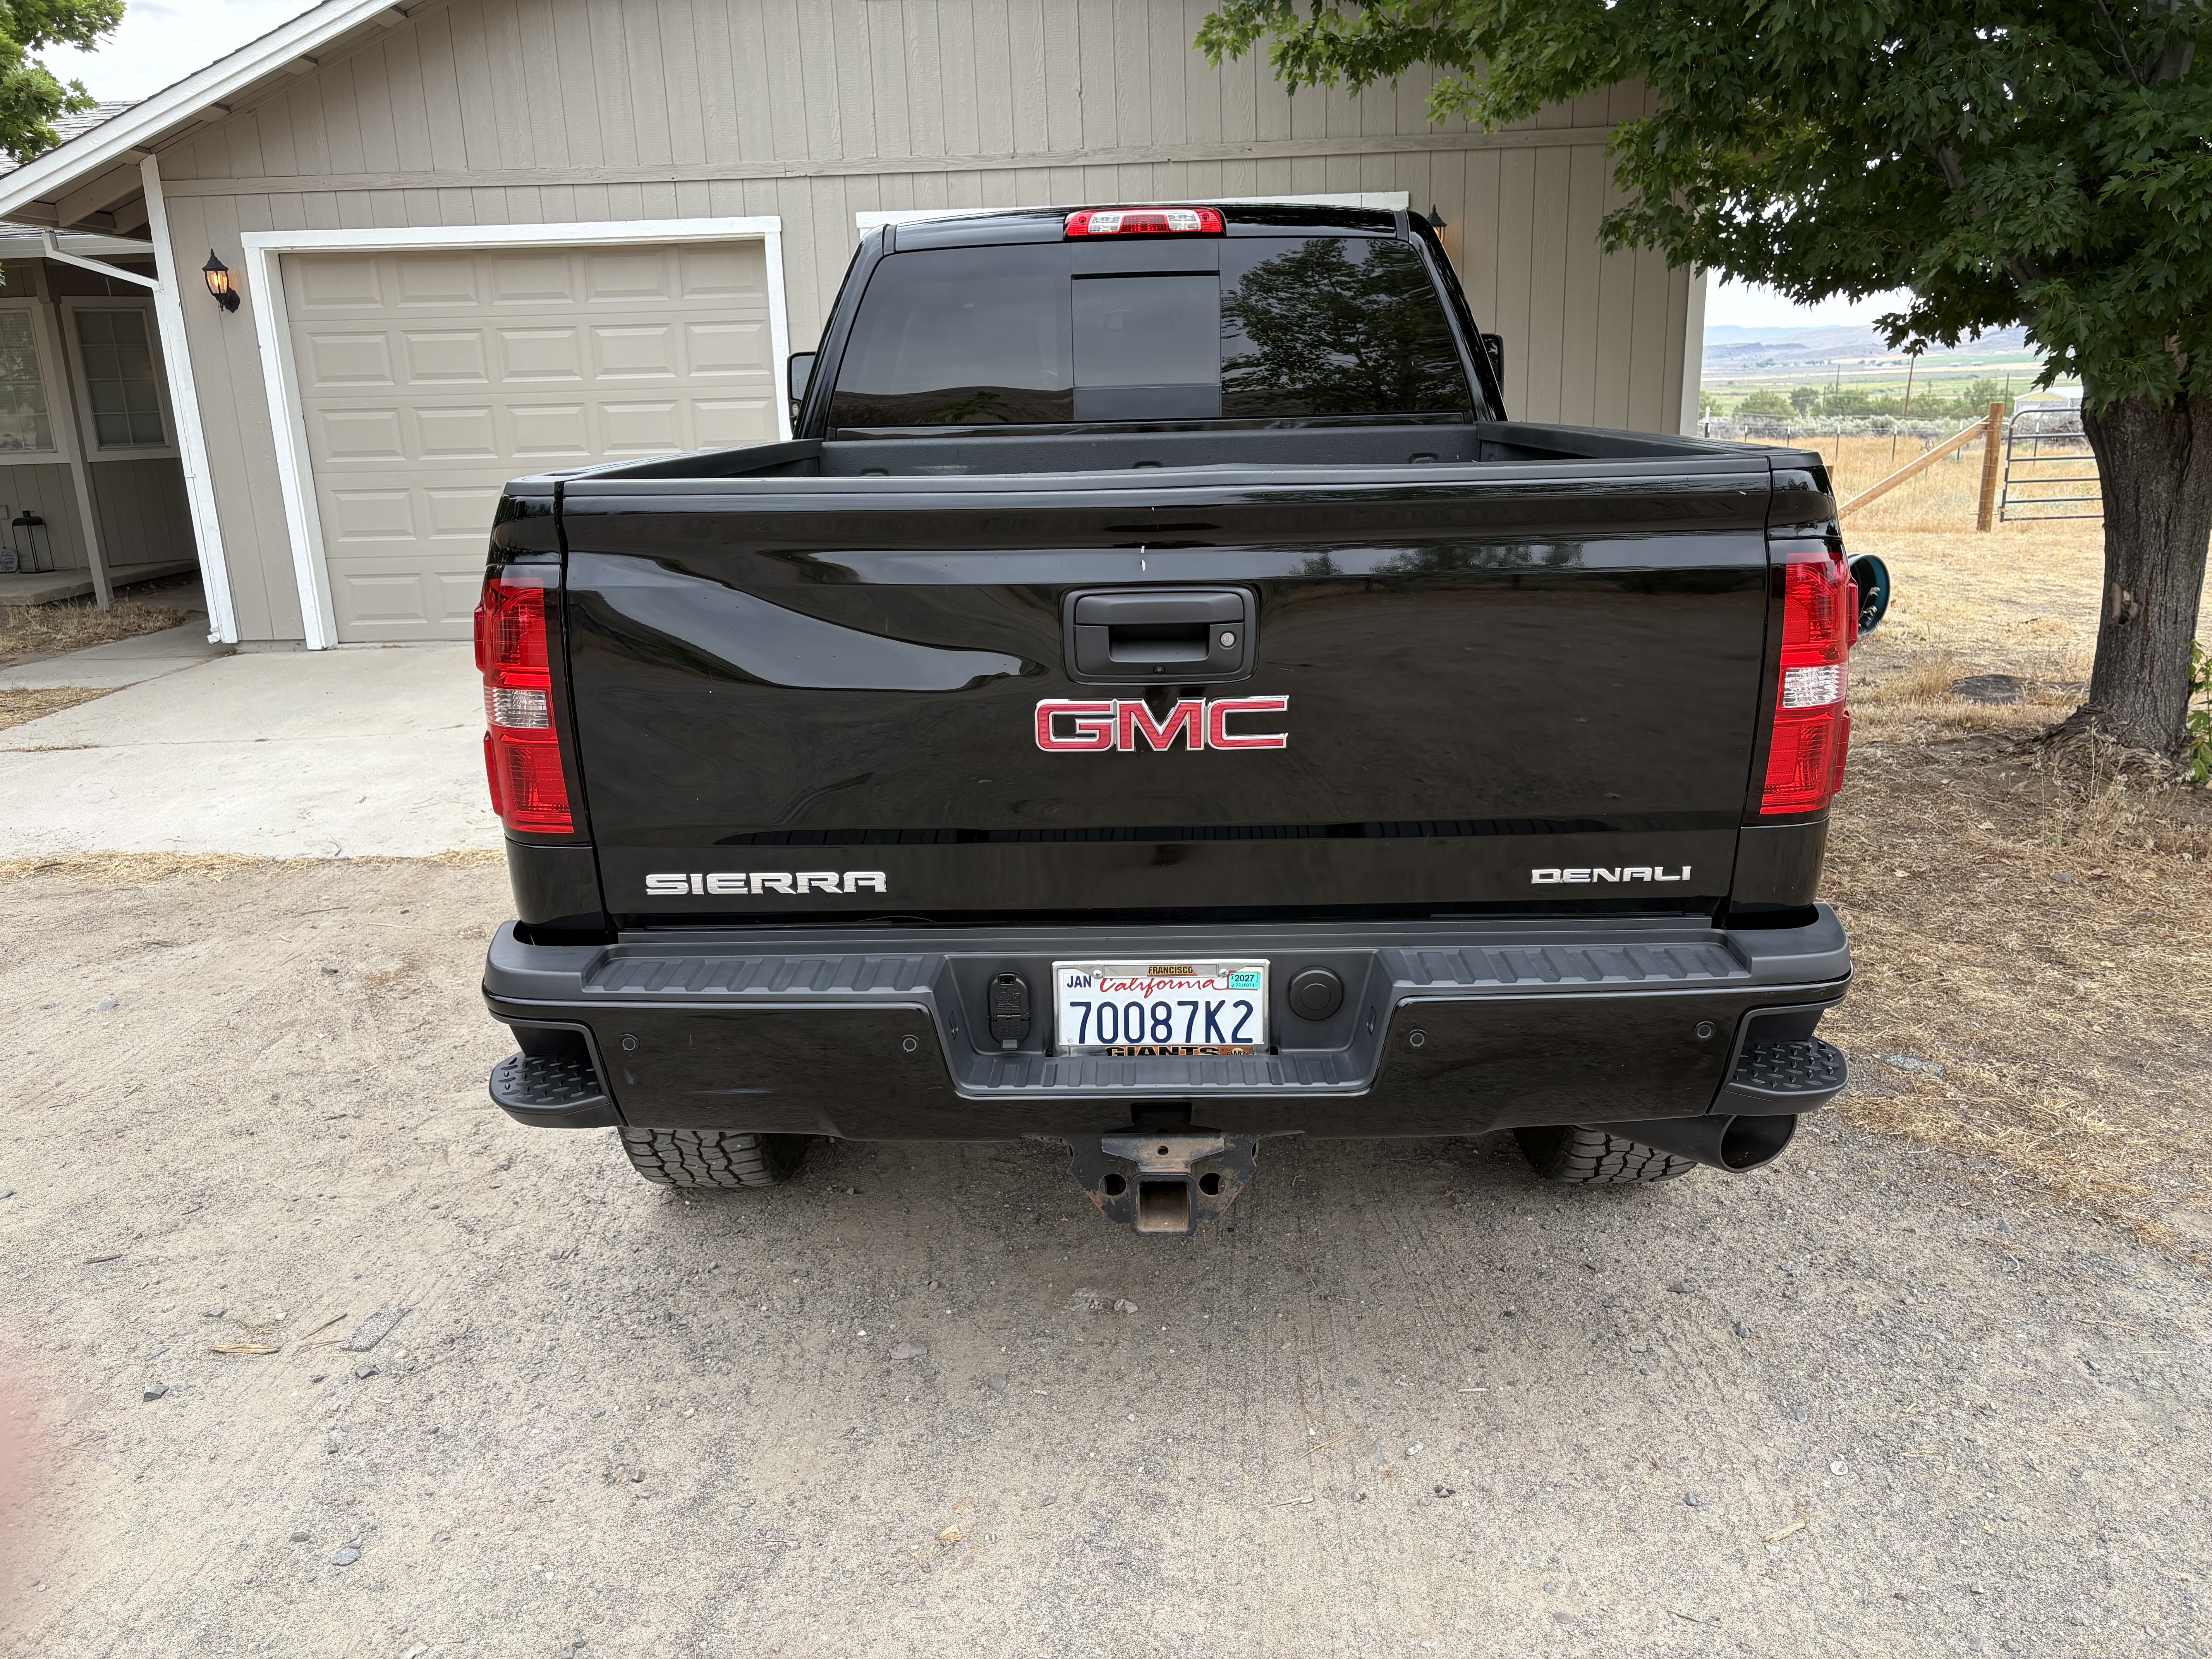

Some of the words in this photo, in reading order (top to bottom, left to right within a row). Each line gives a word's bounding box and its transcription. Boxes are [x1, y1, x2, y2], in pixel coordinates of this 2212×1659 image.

[1035, 695, 1289, 752] GMC
[646, 871, 887, 895] SIERRA
[1531, 866, 1692, 884] DENALI
[1148, 966, 1193, 974] FRANCISCO
[1067, 975, 1092, 988] JAN
[1099, 978, 1215, 999] California
[1070, 1000, 1253, 1044] 70087K2
[1106, 1046, 1219, 1056] GIANTS
